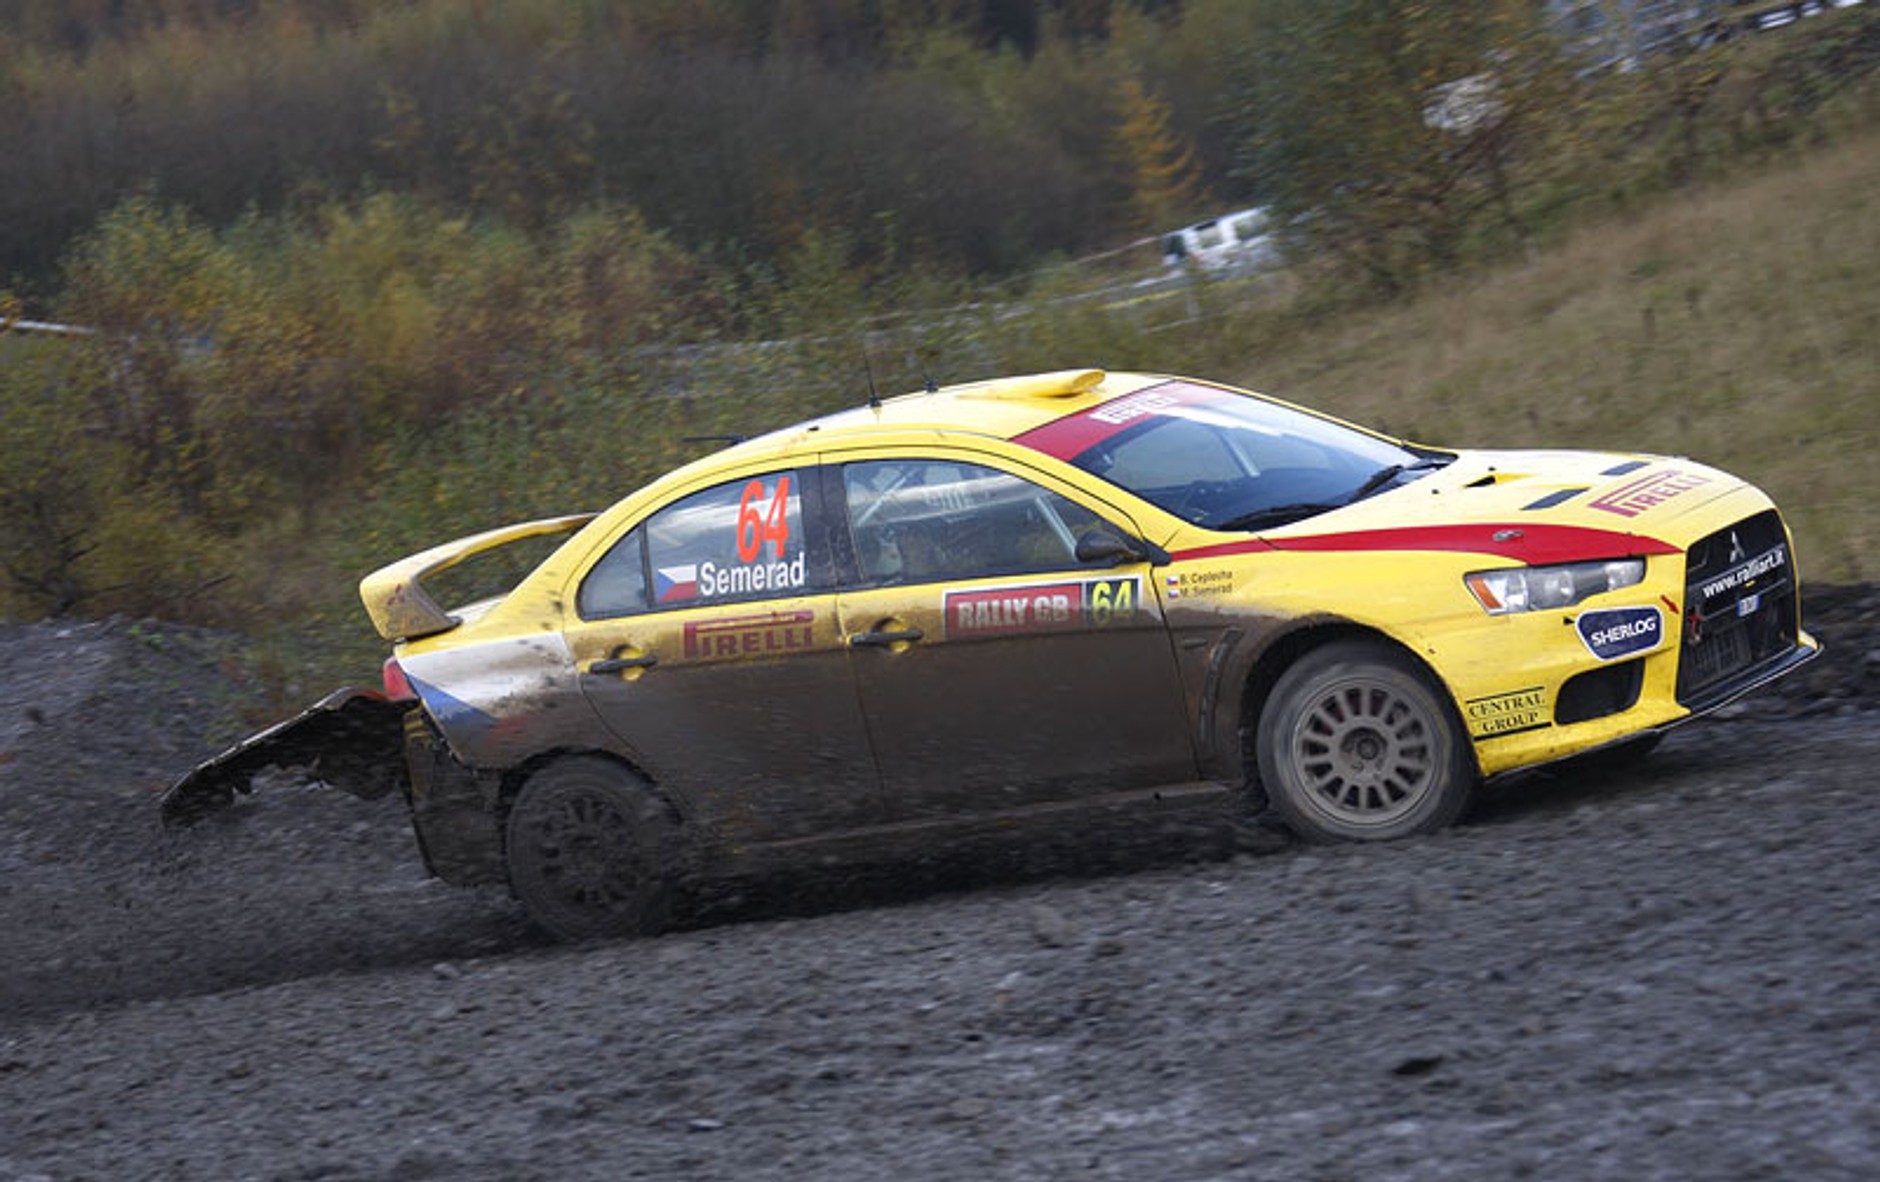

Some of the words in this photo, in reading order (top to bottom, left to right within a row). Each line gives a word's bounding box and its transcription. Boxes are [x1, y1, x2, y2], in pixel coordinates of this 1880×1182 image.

[1587, 470, 1713, 518] PIRELLI
[736, 475, 790, 563] 64
[699, 552, 805, 596] Semerad
[957, 597, 1028, 628] RALLY
[1034, 594, 1069, 622] GB
[1092, 579, 1133, 625] 64
[683, 609, 815, 658] PIRELLI
[1590, 615, 1658, 647] SHERLOG
[1468, 693, 1546, 718] CENTRAL
[1482, 711, 1539, 733] GROUP
